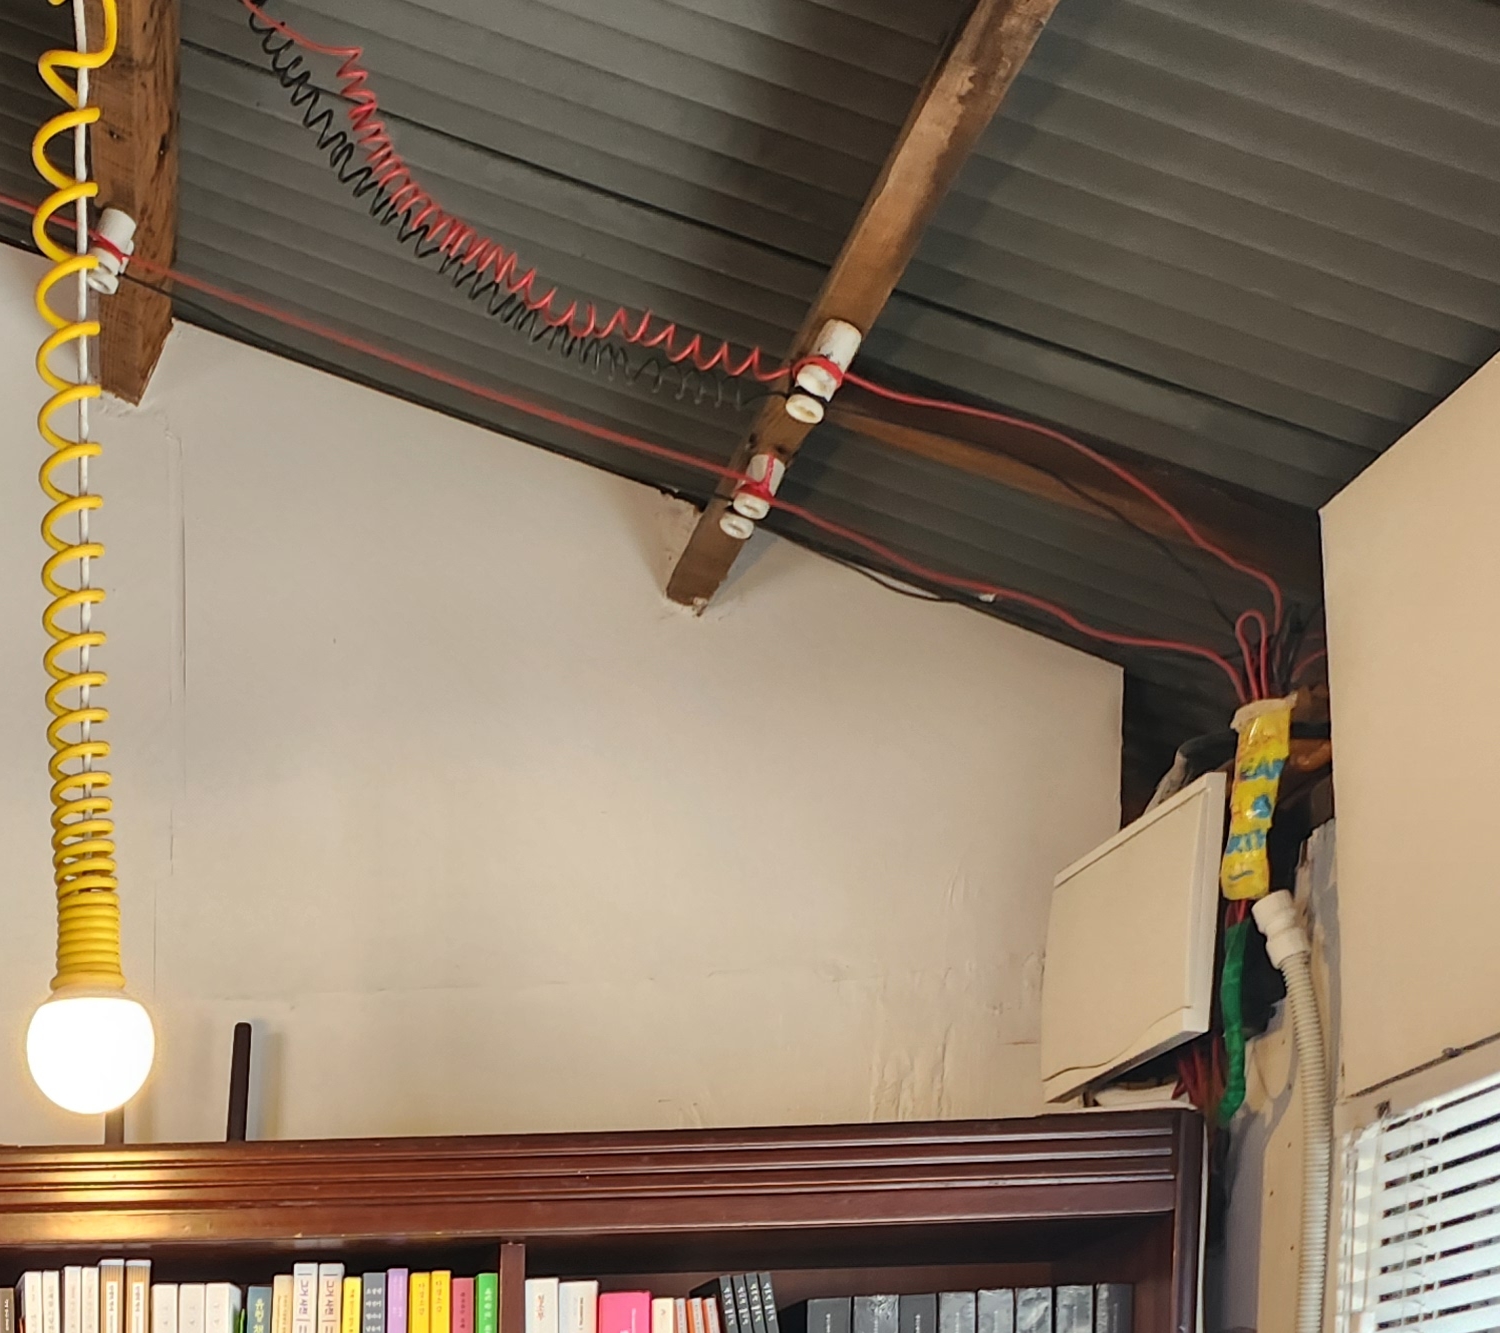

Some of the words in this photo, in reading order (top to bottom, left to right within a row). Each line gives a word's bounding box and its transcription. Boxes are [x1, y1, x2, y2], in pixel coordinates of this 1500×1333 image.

[299, 1279, 309, 1297] 그거
[325, 1279, 335, 1298] 그거
[254, 1298, 265, 1322] 유럽
[299, 1298, 309, 1315] 사전
[325, 1298, 335, 1316] 사전
